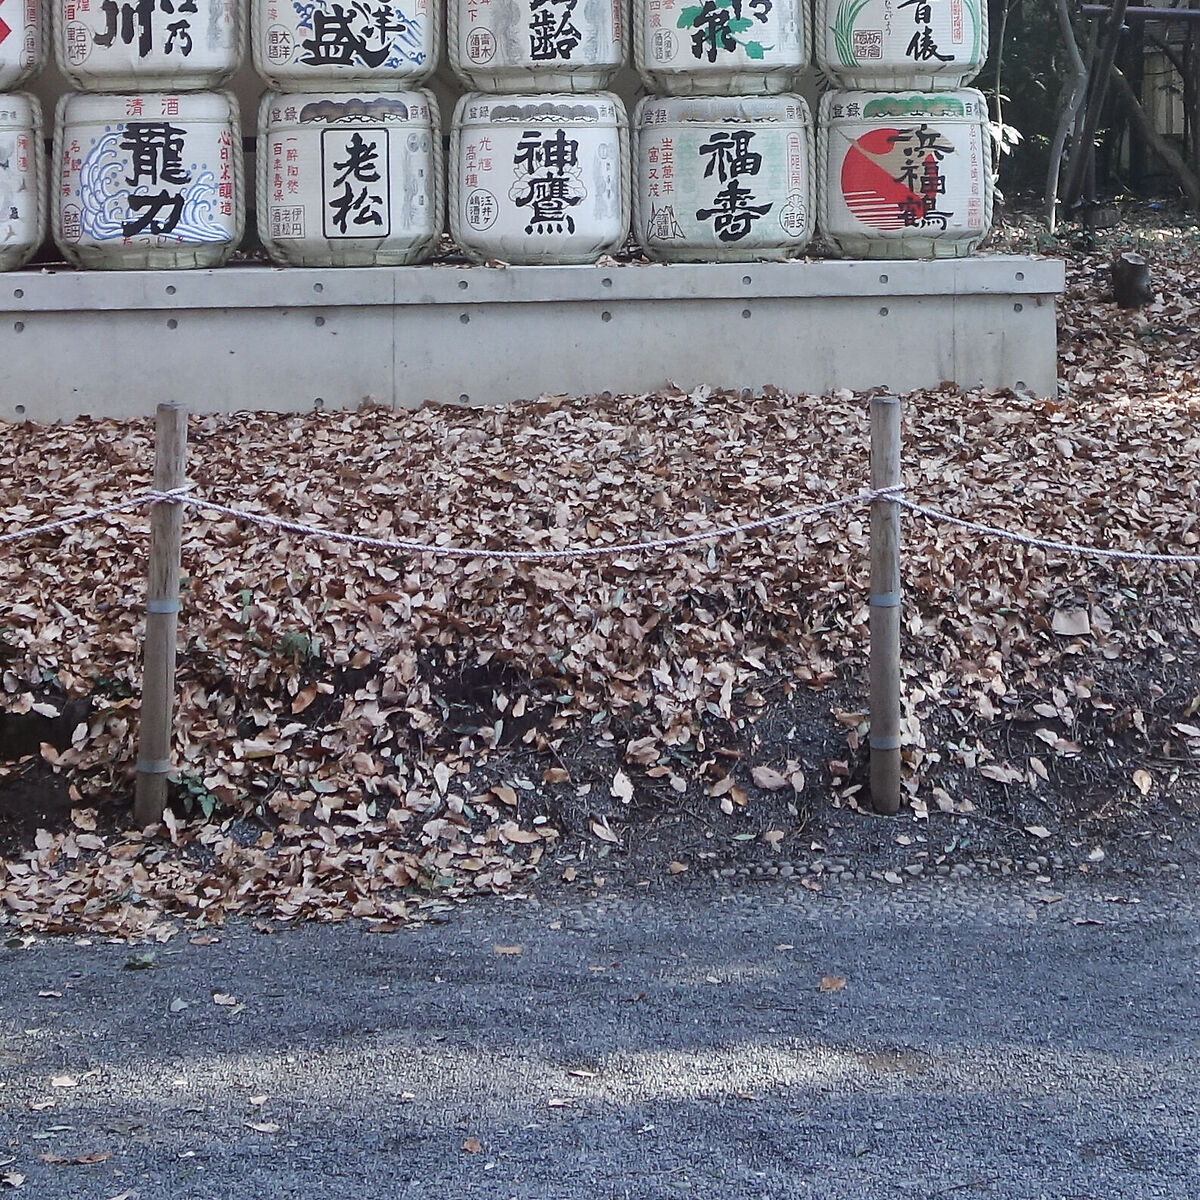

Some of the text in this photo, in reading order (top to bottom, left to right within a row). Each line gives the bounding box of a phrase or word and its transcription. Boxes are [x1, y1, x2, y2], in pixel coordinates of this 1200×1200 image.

[125, 99, 178, 116] 清酒
[120, 122, 192, 237] 龍力
[329, 133, 384, 234] 老松
[515, 129, 580, 236] 神鷹
